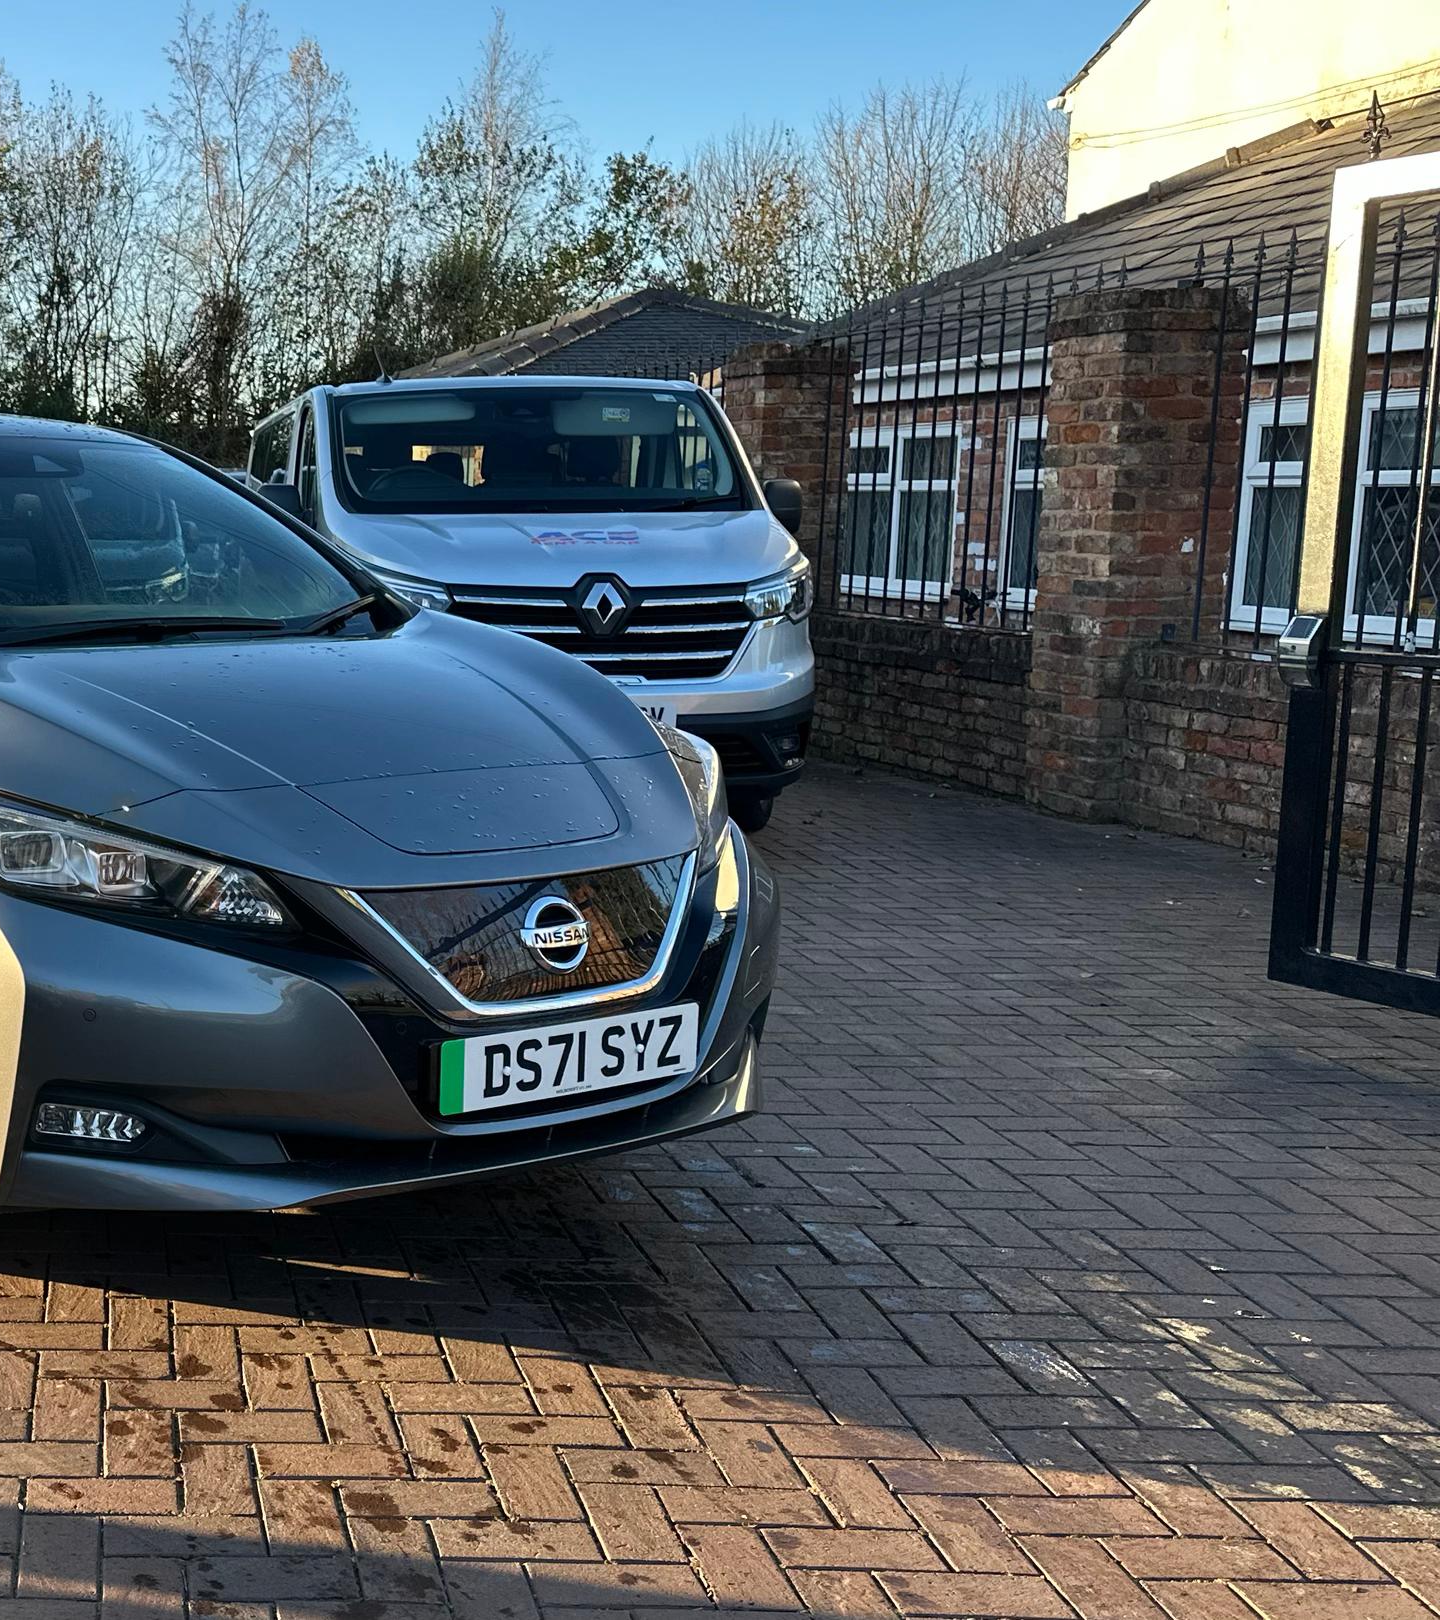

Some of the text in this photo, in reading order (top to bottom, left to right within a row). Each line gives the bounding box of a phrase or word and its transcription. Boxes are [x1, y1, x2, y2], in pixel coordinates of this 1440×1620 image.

[534, 927, 590, 945] NISSAN
[482, 1013, 684, 1099] DS71 SYZ
